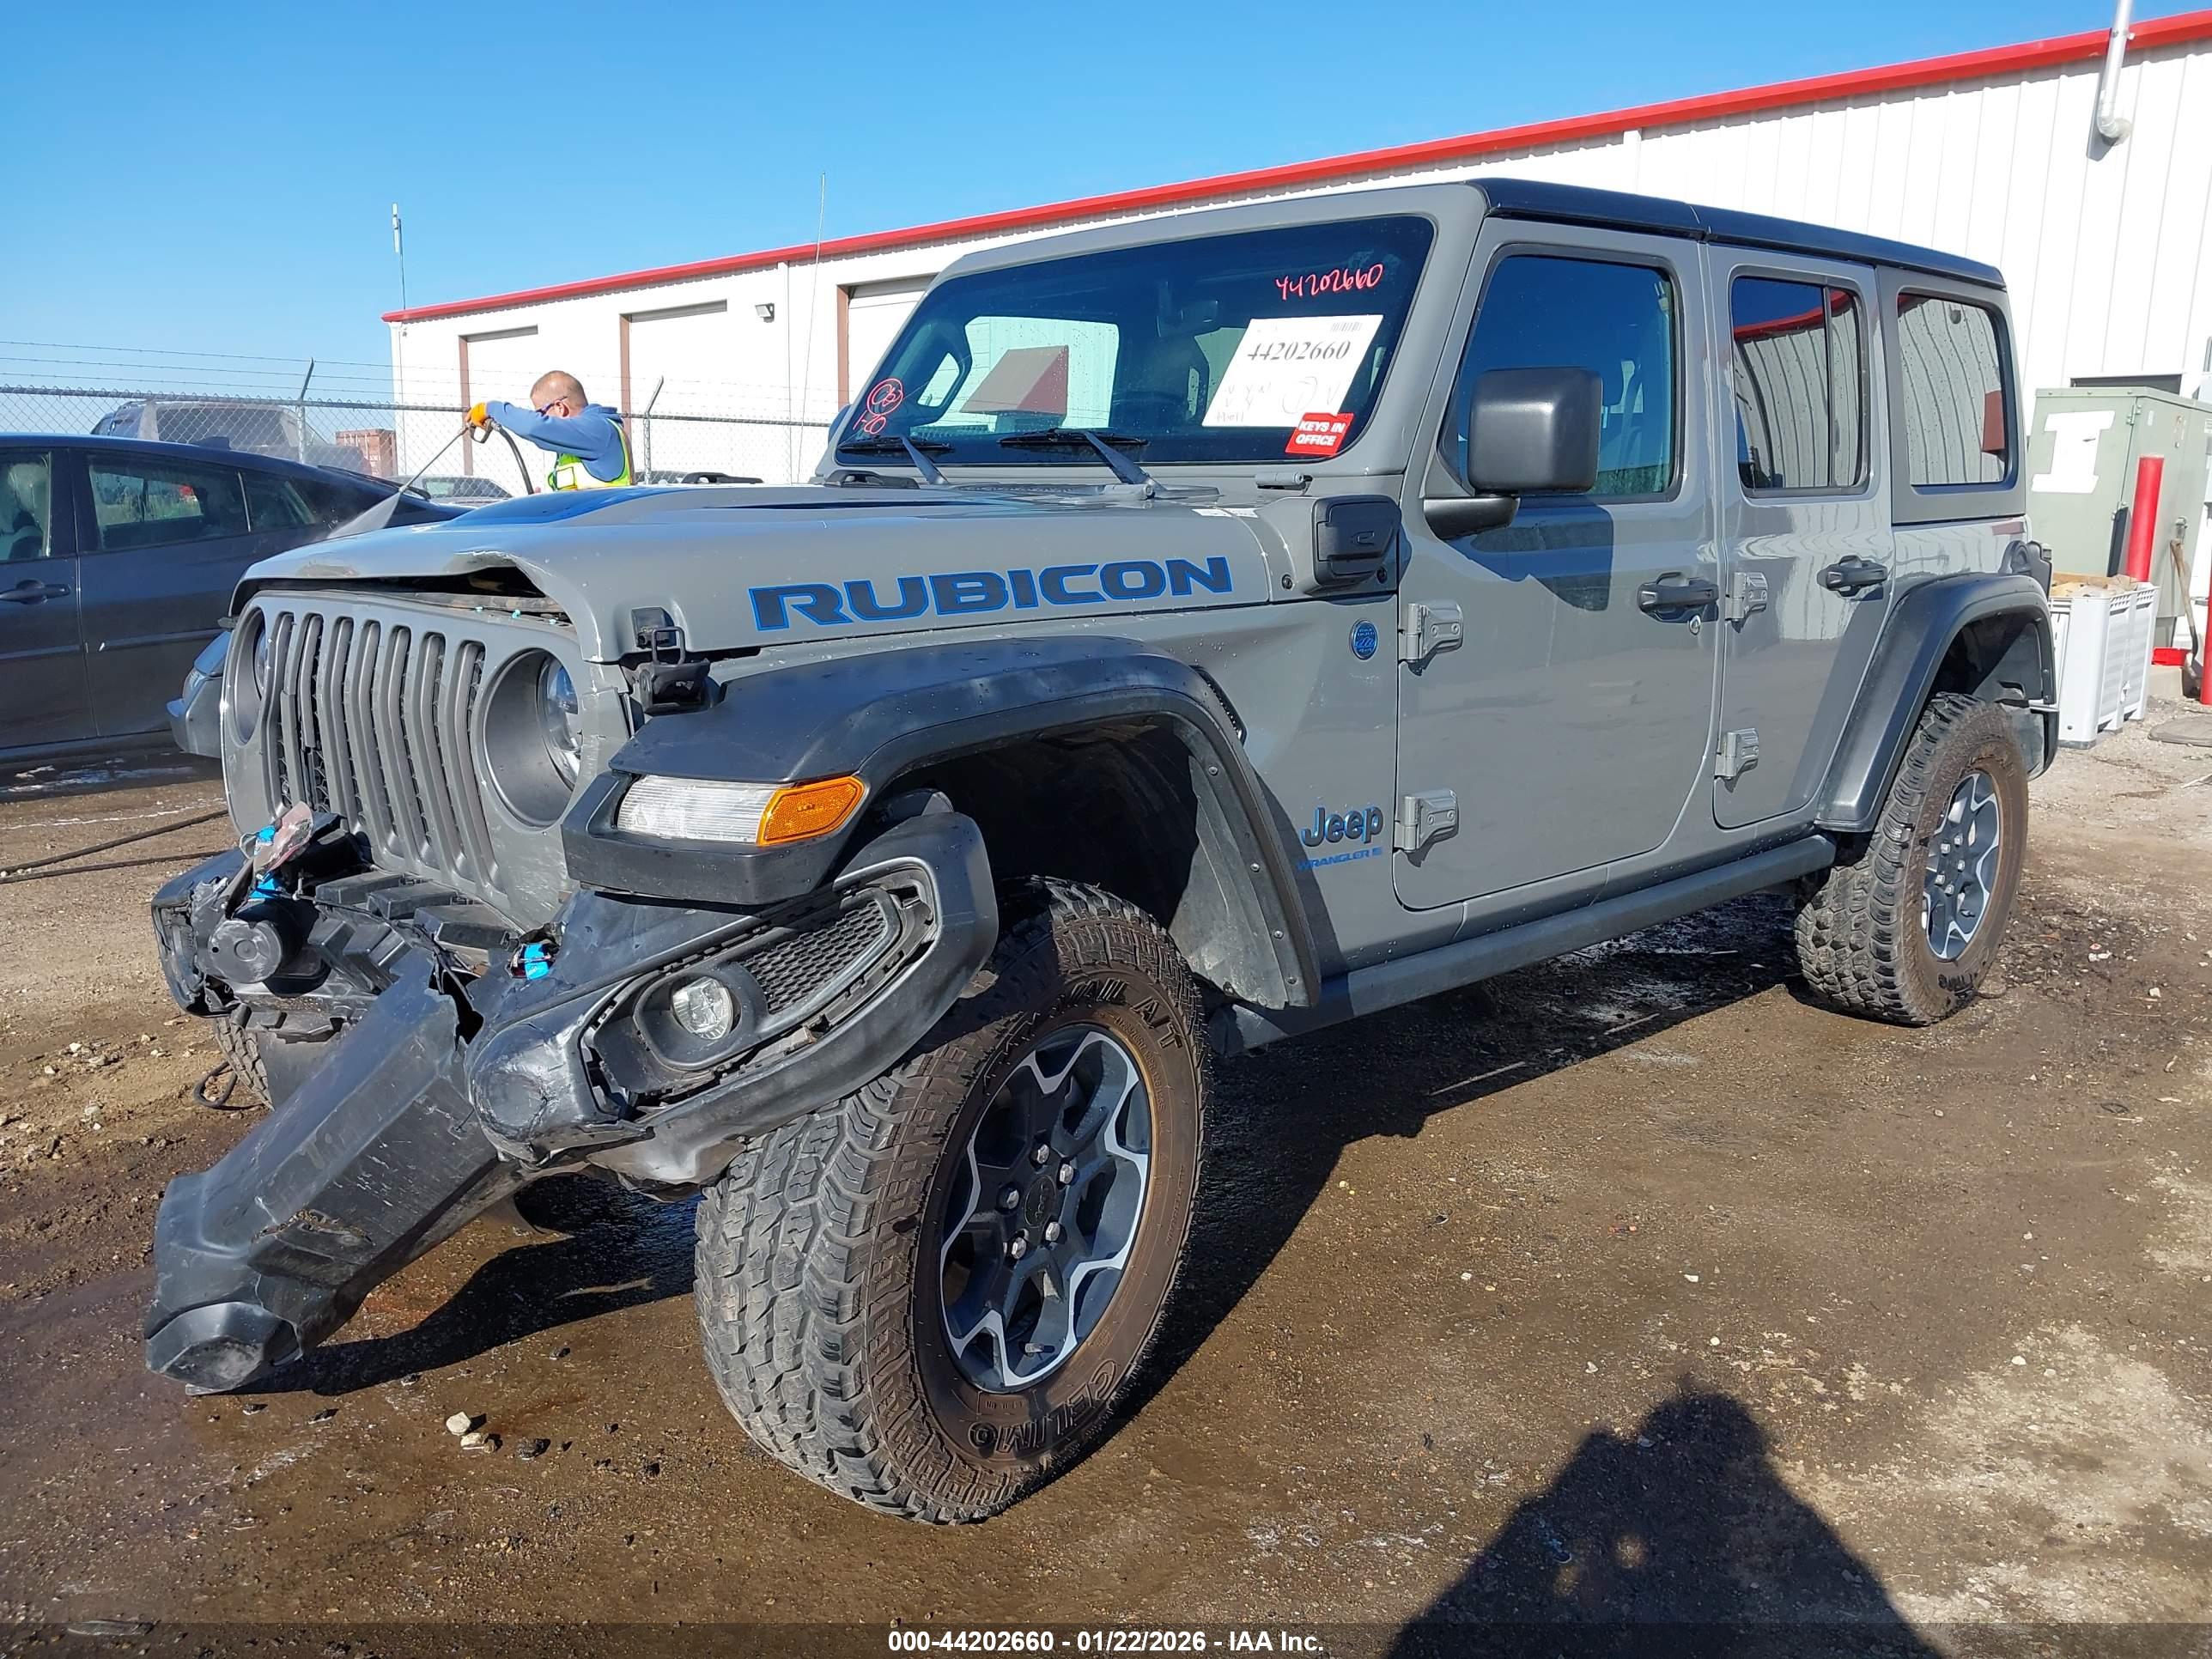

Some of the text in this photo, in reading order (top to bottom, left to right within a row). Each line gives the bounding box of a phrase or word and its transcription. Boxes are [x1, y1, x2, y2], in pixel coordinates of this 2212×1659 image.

[1248, 341, 1351, 361] 44202660
[1297, 421, 1346, 433] KEYS IN
[1295, 434, 1337, 446] OFFICE
[749, 556, 1233, 631] RUBICON
[1301, 806, 1383, 847] Jeep
